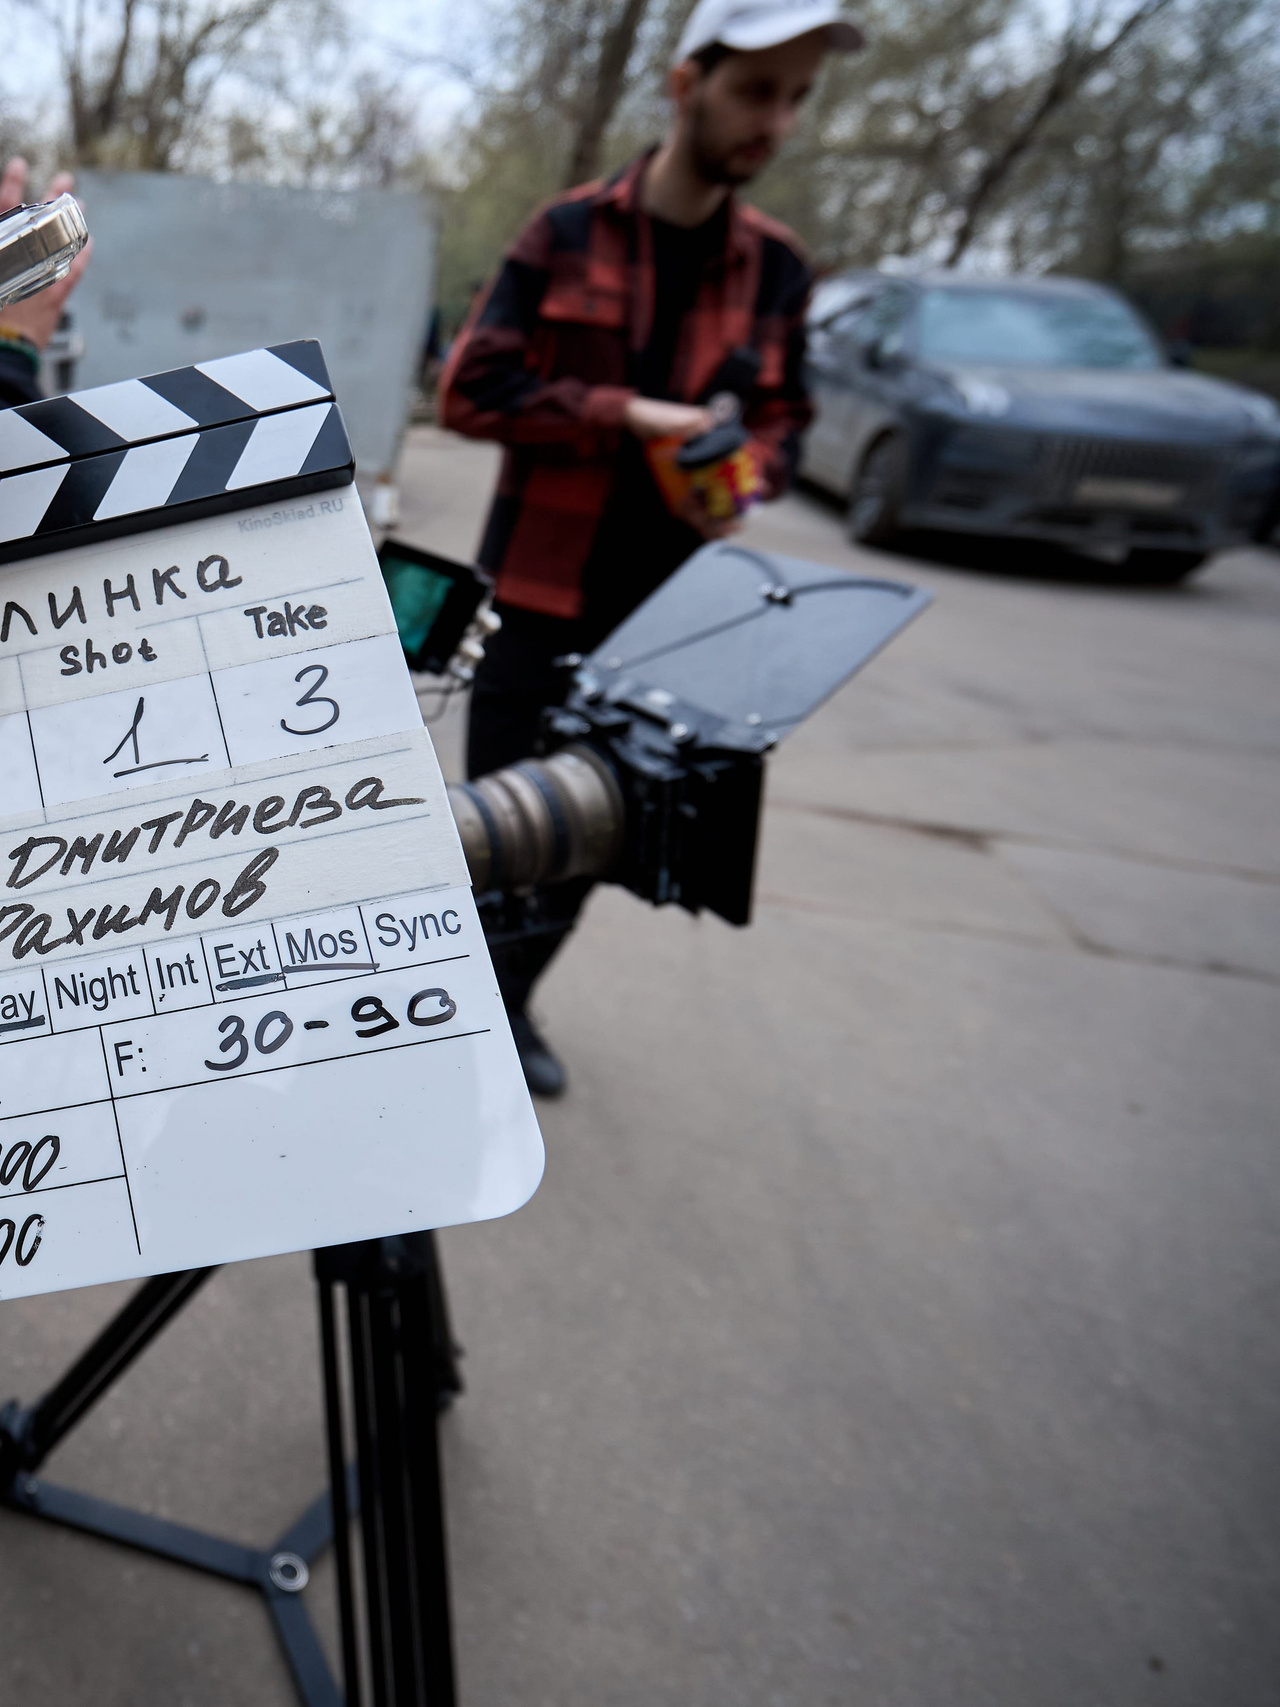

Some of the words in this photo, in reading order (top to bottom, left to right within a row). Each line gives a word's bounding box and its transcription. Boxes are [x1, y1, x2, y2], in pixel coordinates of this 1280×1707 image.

[237, 498, 344, 532] KinoSklad.RU
[244, 601, 328, 640] Take
[60, 637, 158, 676] Shot
[280, 664, 340, 736] 3
[285, 926, 359, 966] Mos
[377, 908, 463, 953] Sync
[156, 954, 199, 990] Int
[216, 940, 271, 978] Ext
[54, 963, 141, 1011] Night
[113, 1039, 148, 1077] F:
